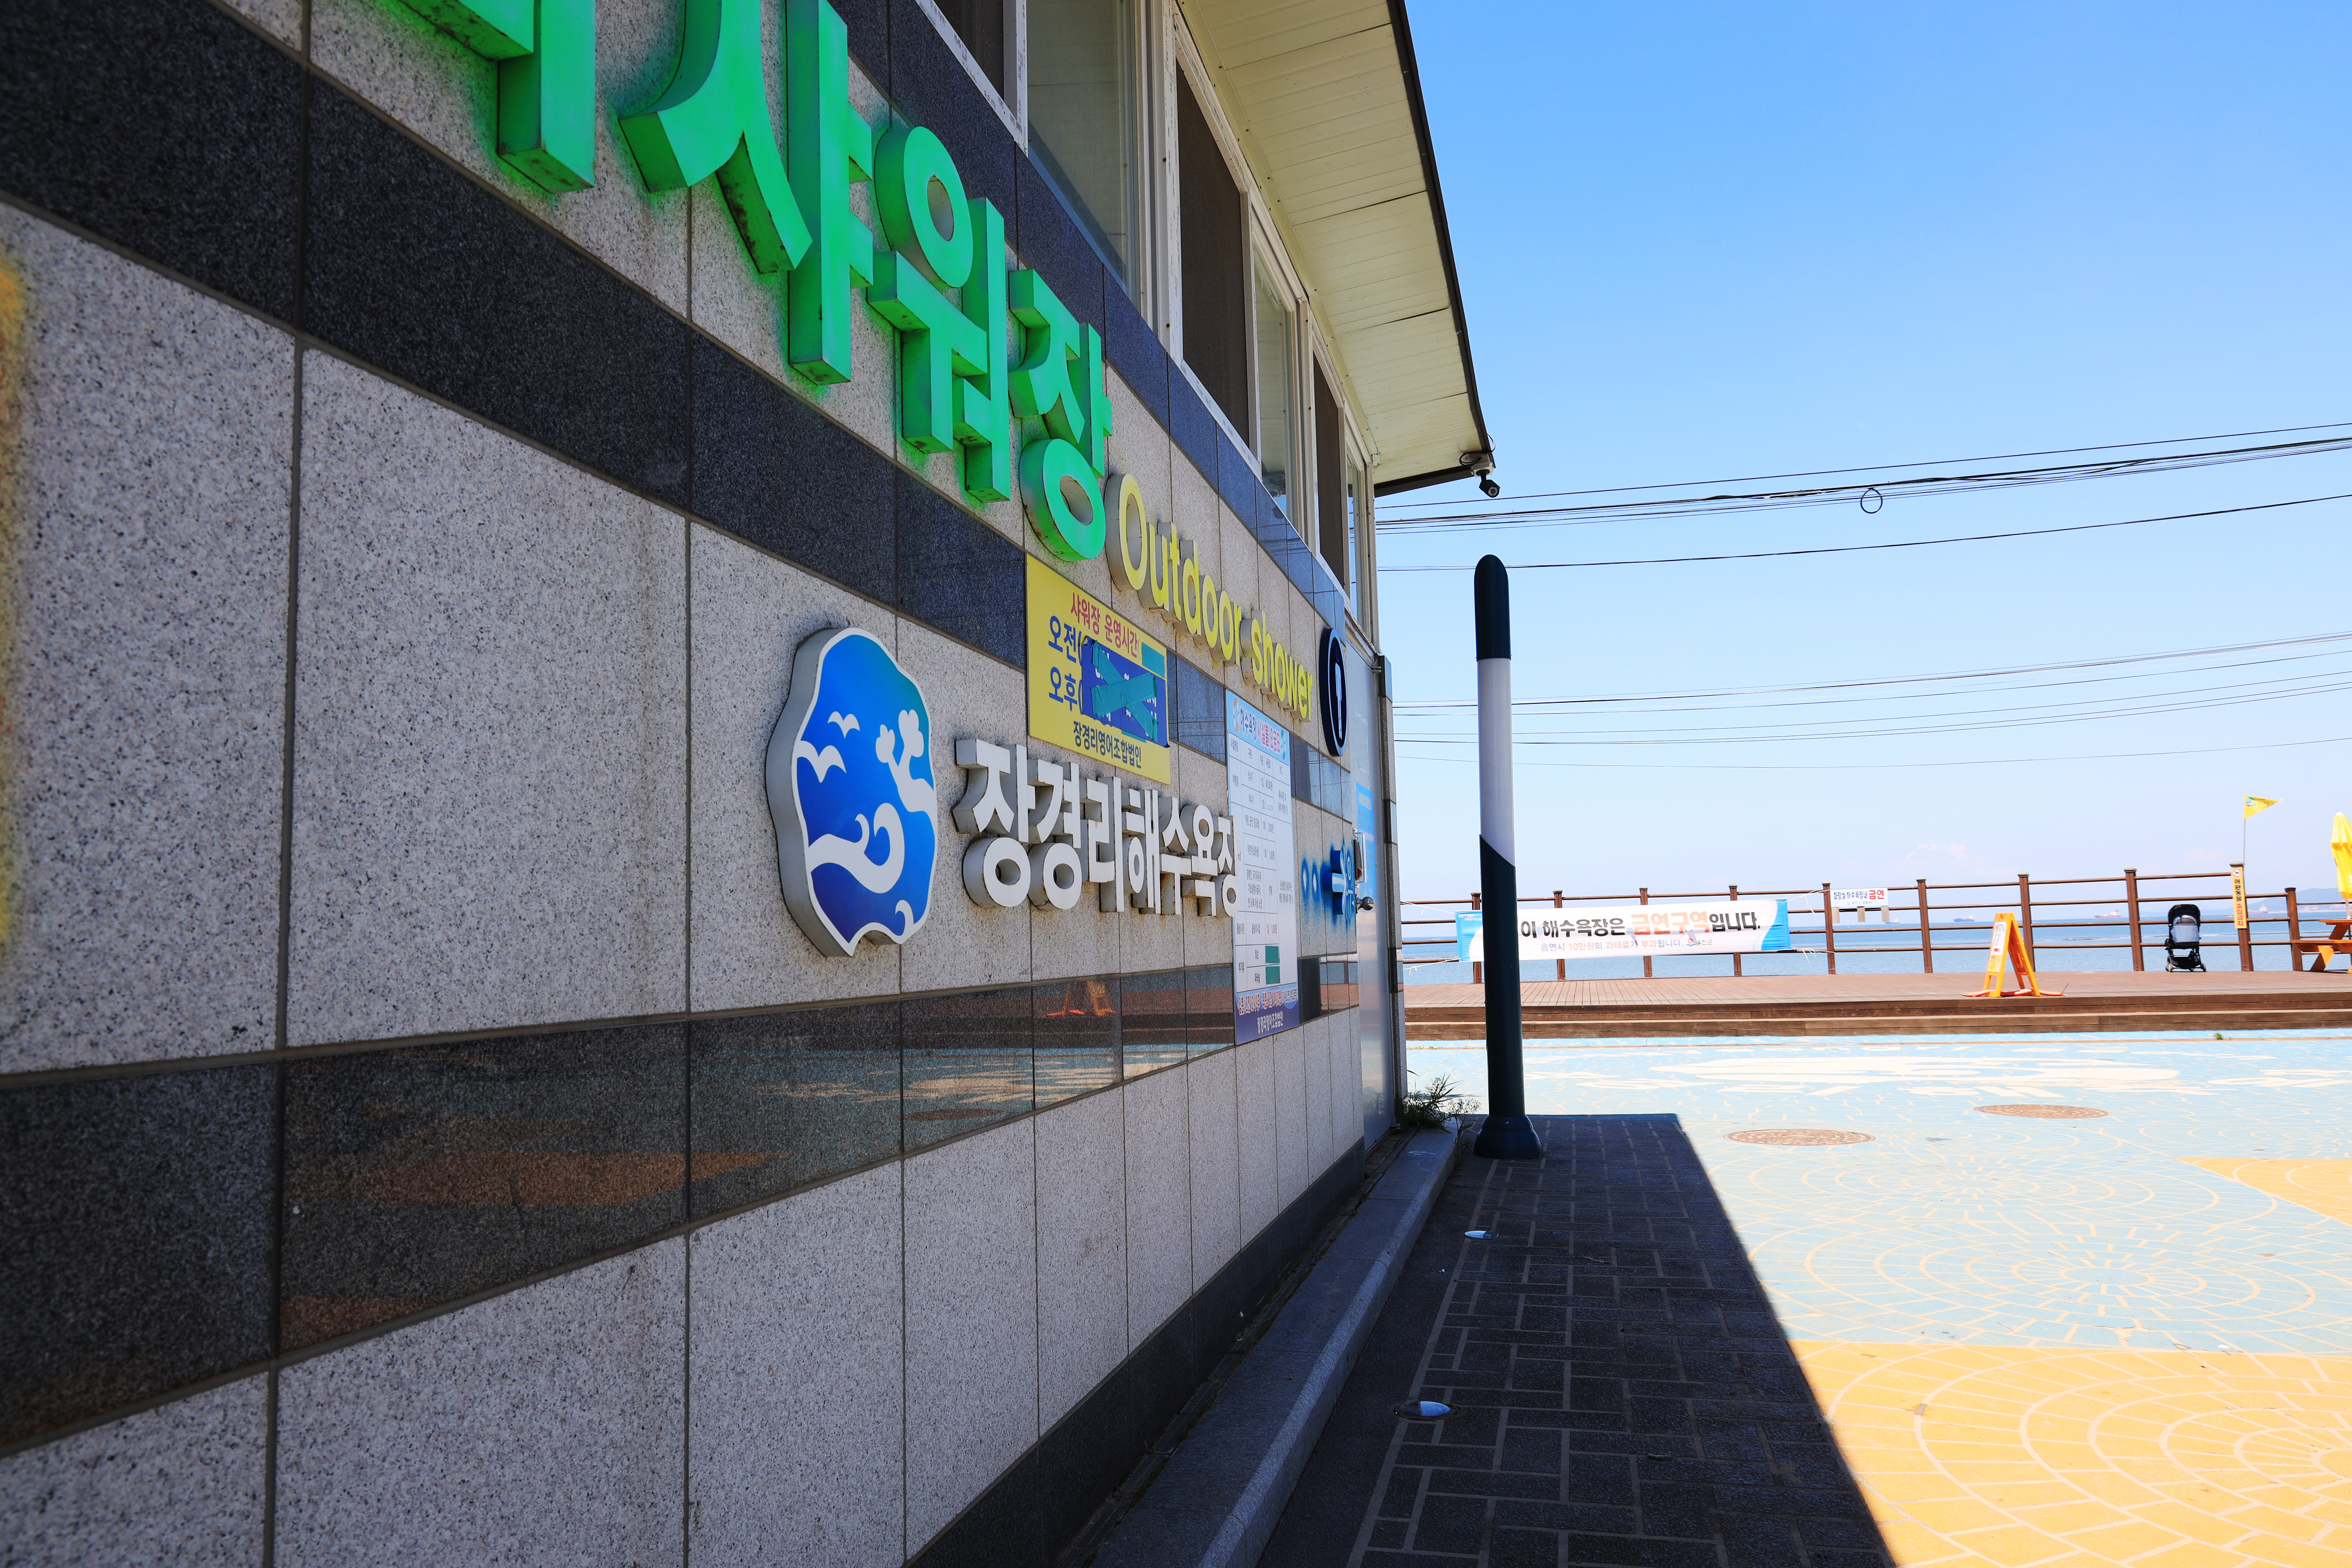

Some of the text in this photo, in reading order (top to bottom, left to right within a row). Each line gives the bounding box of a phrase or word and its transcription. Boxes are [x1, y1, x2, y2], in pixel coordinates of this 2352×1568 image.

[390, 0, 1113, 562] 샤워장
[1070, 592, 1101, 636] 샤워장
[1104, 474, 1241, 667] Outdoor
[1240, 610, 1312, 722] shower
[1073, 720, 1142, 769] 장경리영어조합법인
[1240, 707, 1281, 753] 해수욕장 시설물 요금표
[953, 738, 1239, 917] 장경리해수욕장
[1869, 889, 1885, 900] 금연
[1521, 911, 1761, 938] 이 해수욕장은 금연구역입니다.
[1540, 942, 1565, 952] 흡연시
[1568, 941, 1603, 950] 10만원의
[1605, 940, 1639, 949] 과태료가
[1641, 938, 1684, 948] 부과됩니다.
